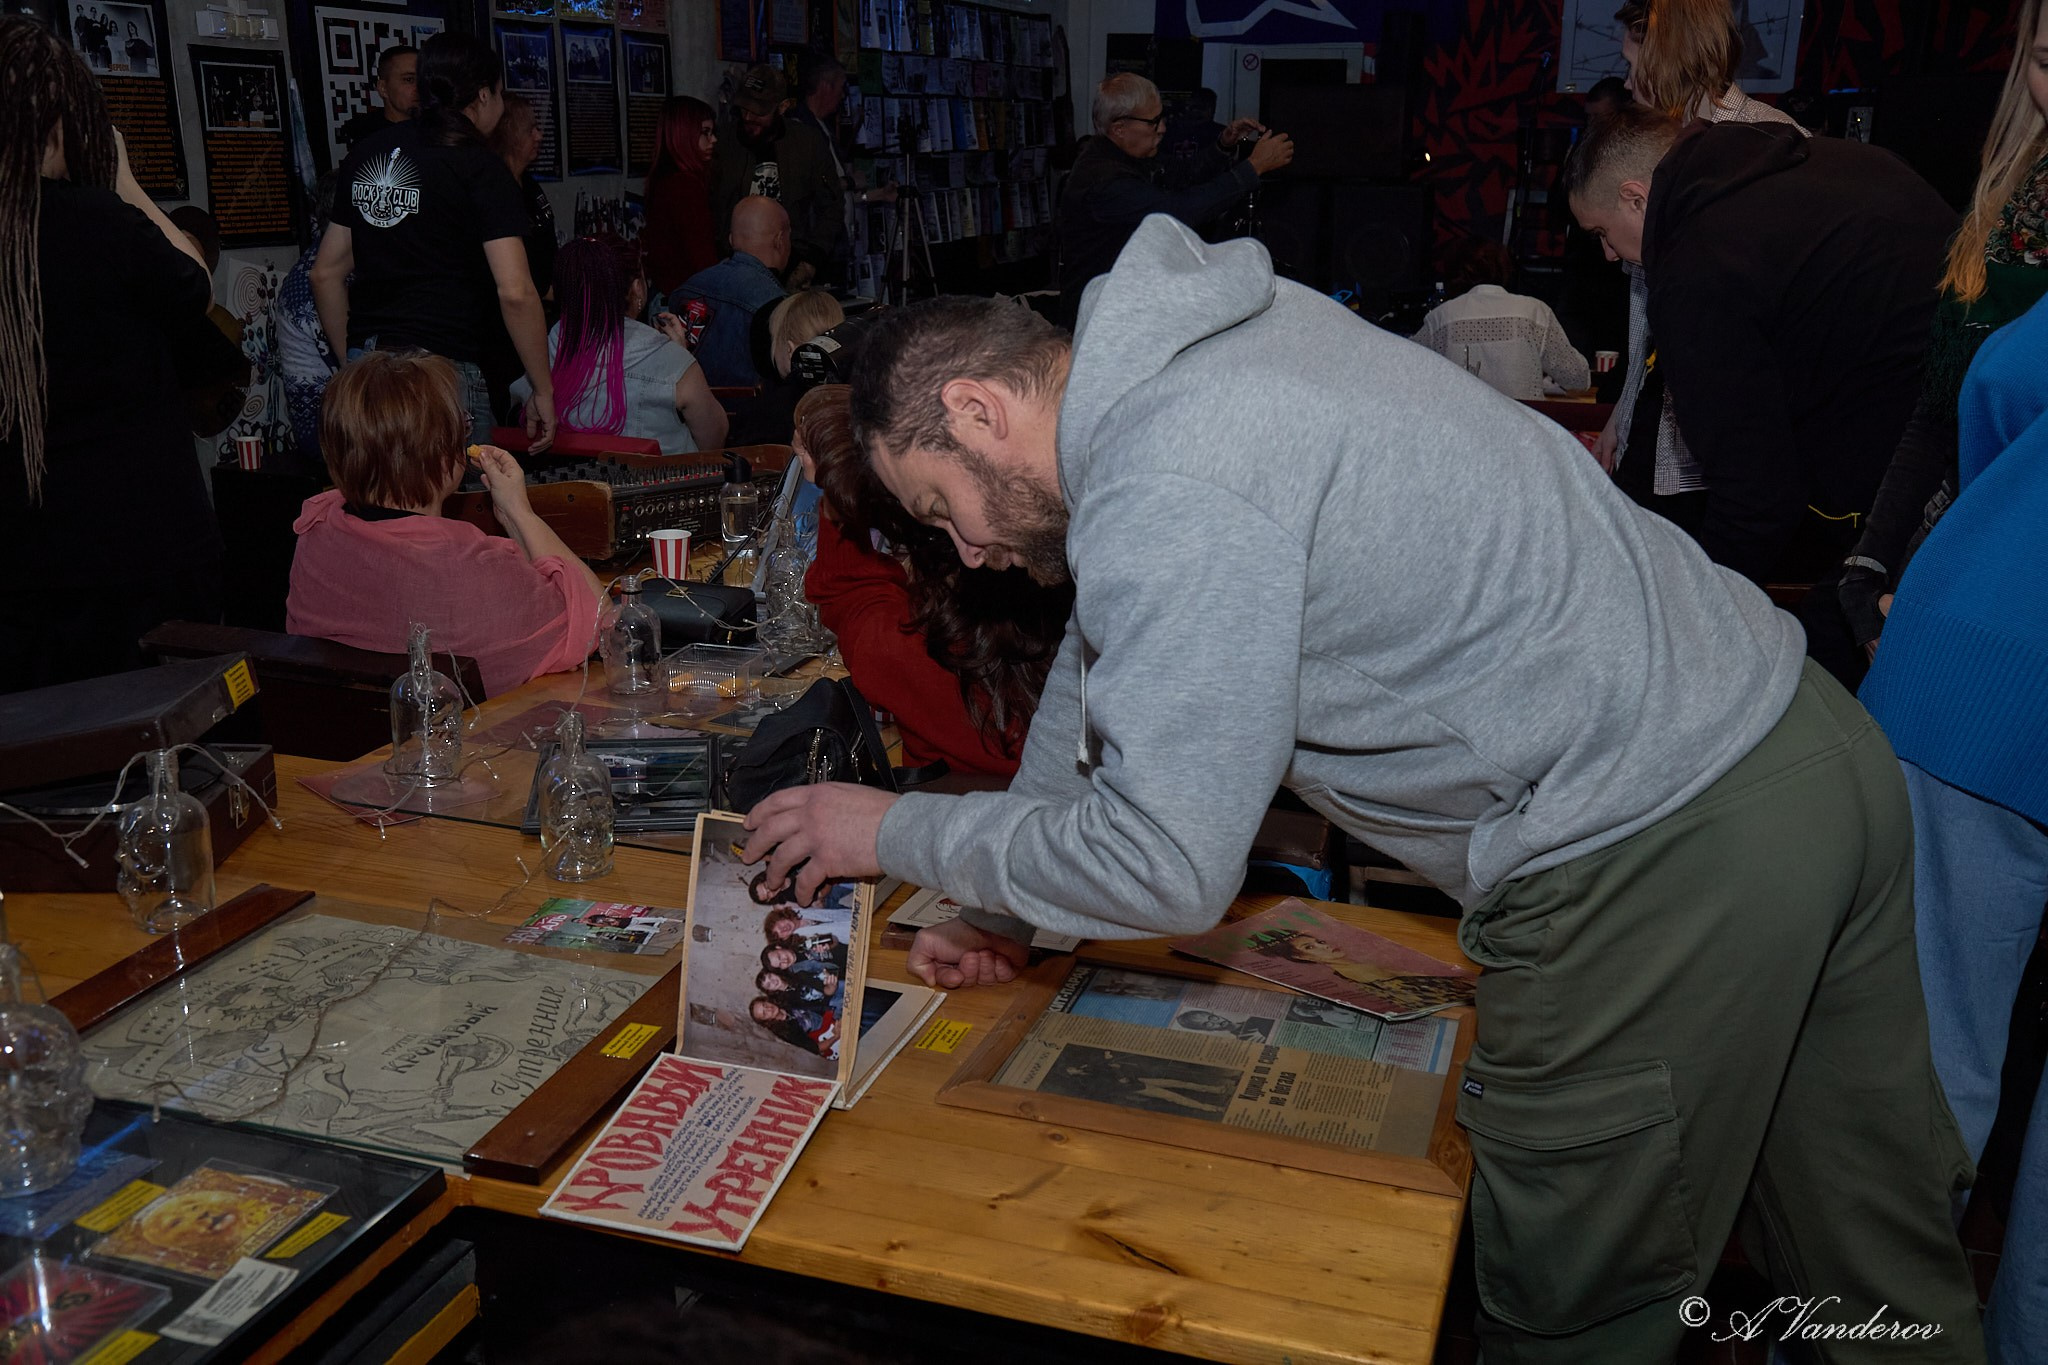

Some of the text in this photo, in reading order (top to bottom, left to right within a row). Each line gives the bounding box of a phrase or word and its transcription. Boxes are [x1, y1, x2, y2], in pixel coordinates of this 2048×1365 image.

[353, 184, 418, 208] ROCK CLUB
[556, 1056, 726, 1212] КРОВАВЫЙ
[667, 1075, 833, 1243] УТРЕННИК
